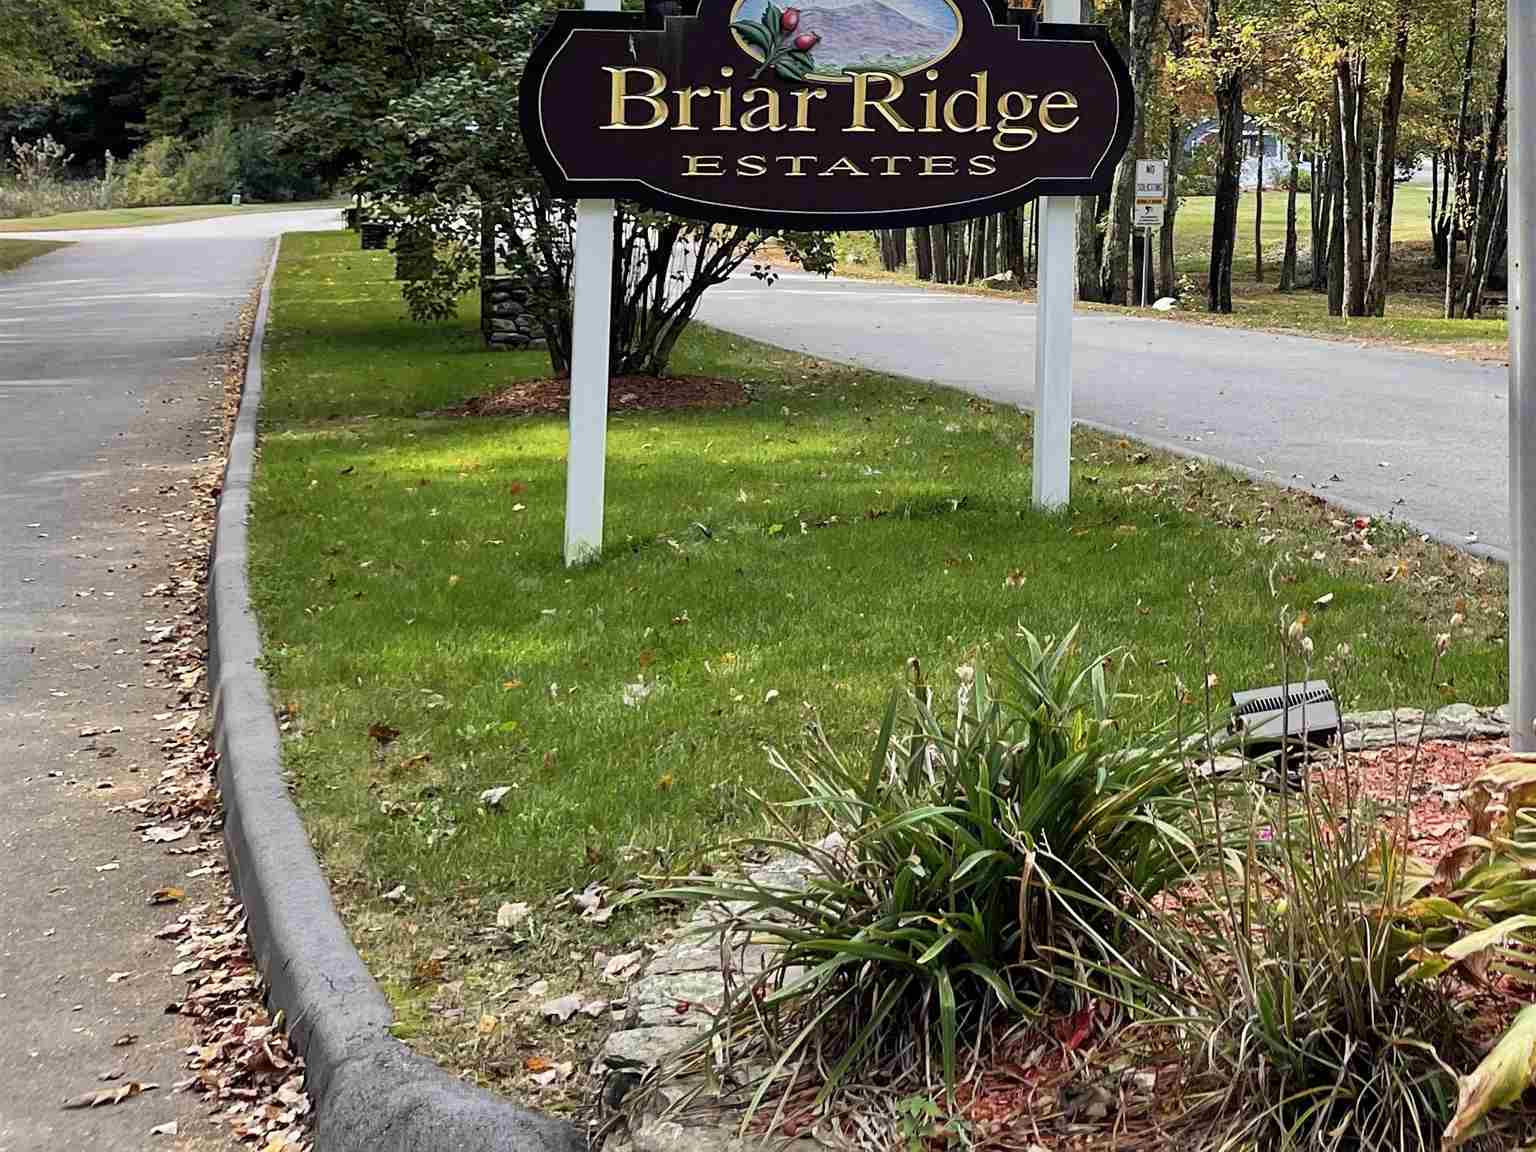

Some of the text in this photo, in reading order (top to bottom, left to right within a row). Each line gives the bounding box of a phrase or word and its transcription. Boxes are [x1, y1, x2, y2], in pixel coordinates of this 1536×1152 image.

[599, 65, 1081, 152] Briar Ridge
[680, 154, 998, 178] ESTATES
